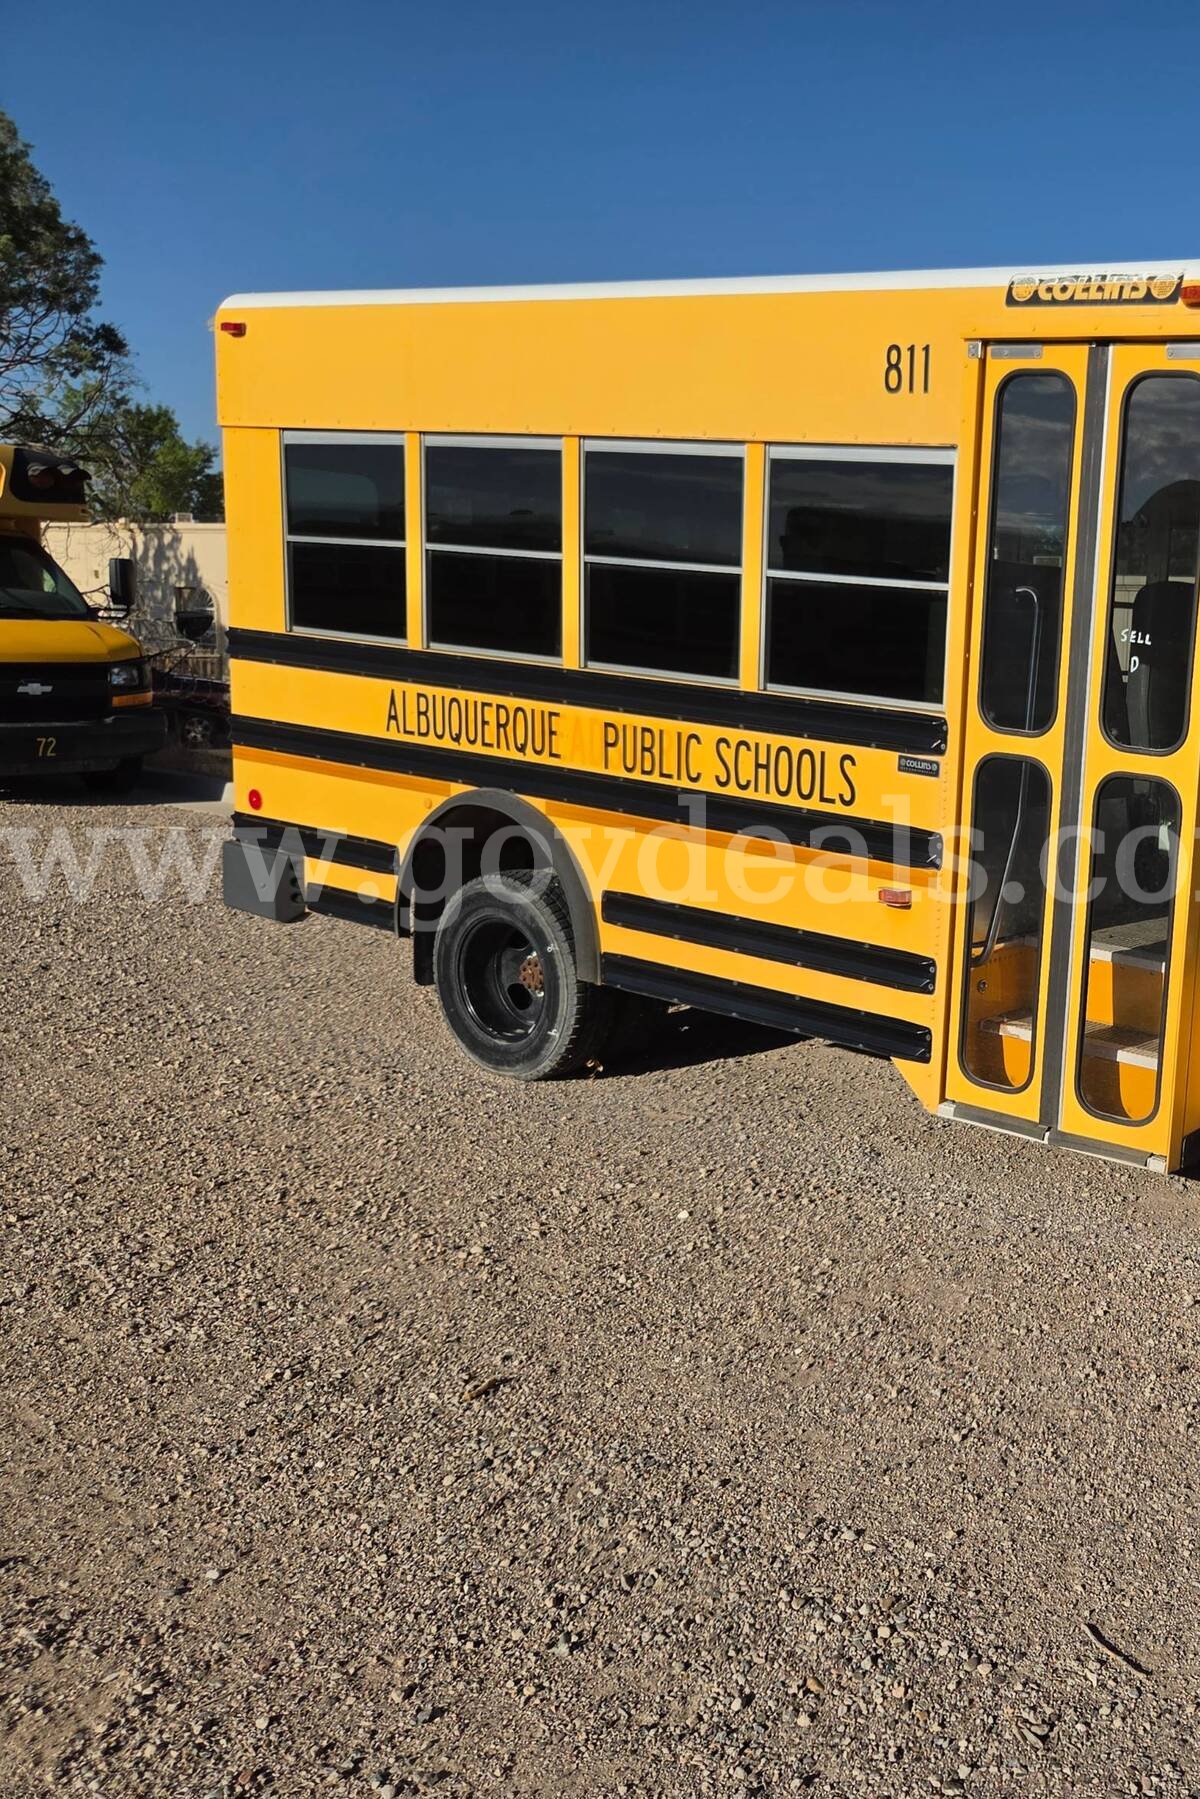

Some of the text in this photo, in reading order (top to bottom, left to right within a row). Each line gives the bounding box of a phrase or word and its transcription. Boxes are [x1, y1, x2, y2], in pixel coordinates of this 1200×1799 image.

[1038, 274, 1148, 301] COLLINS
[884, 343, 931, 395] 811
[1120, 628, 1152, 646] SELL
[1130, 655, 1140, 673] D
[36, 737, 57, 758] 72
[386, 688, 562, 759] ALBUQUERQUE
[603, 721, 703, 784] PUBLIC
[714, 736, 857, 808] SCHOOLS
[906, 759, 932, 771] COLLINS
